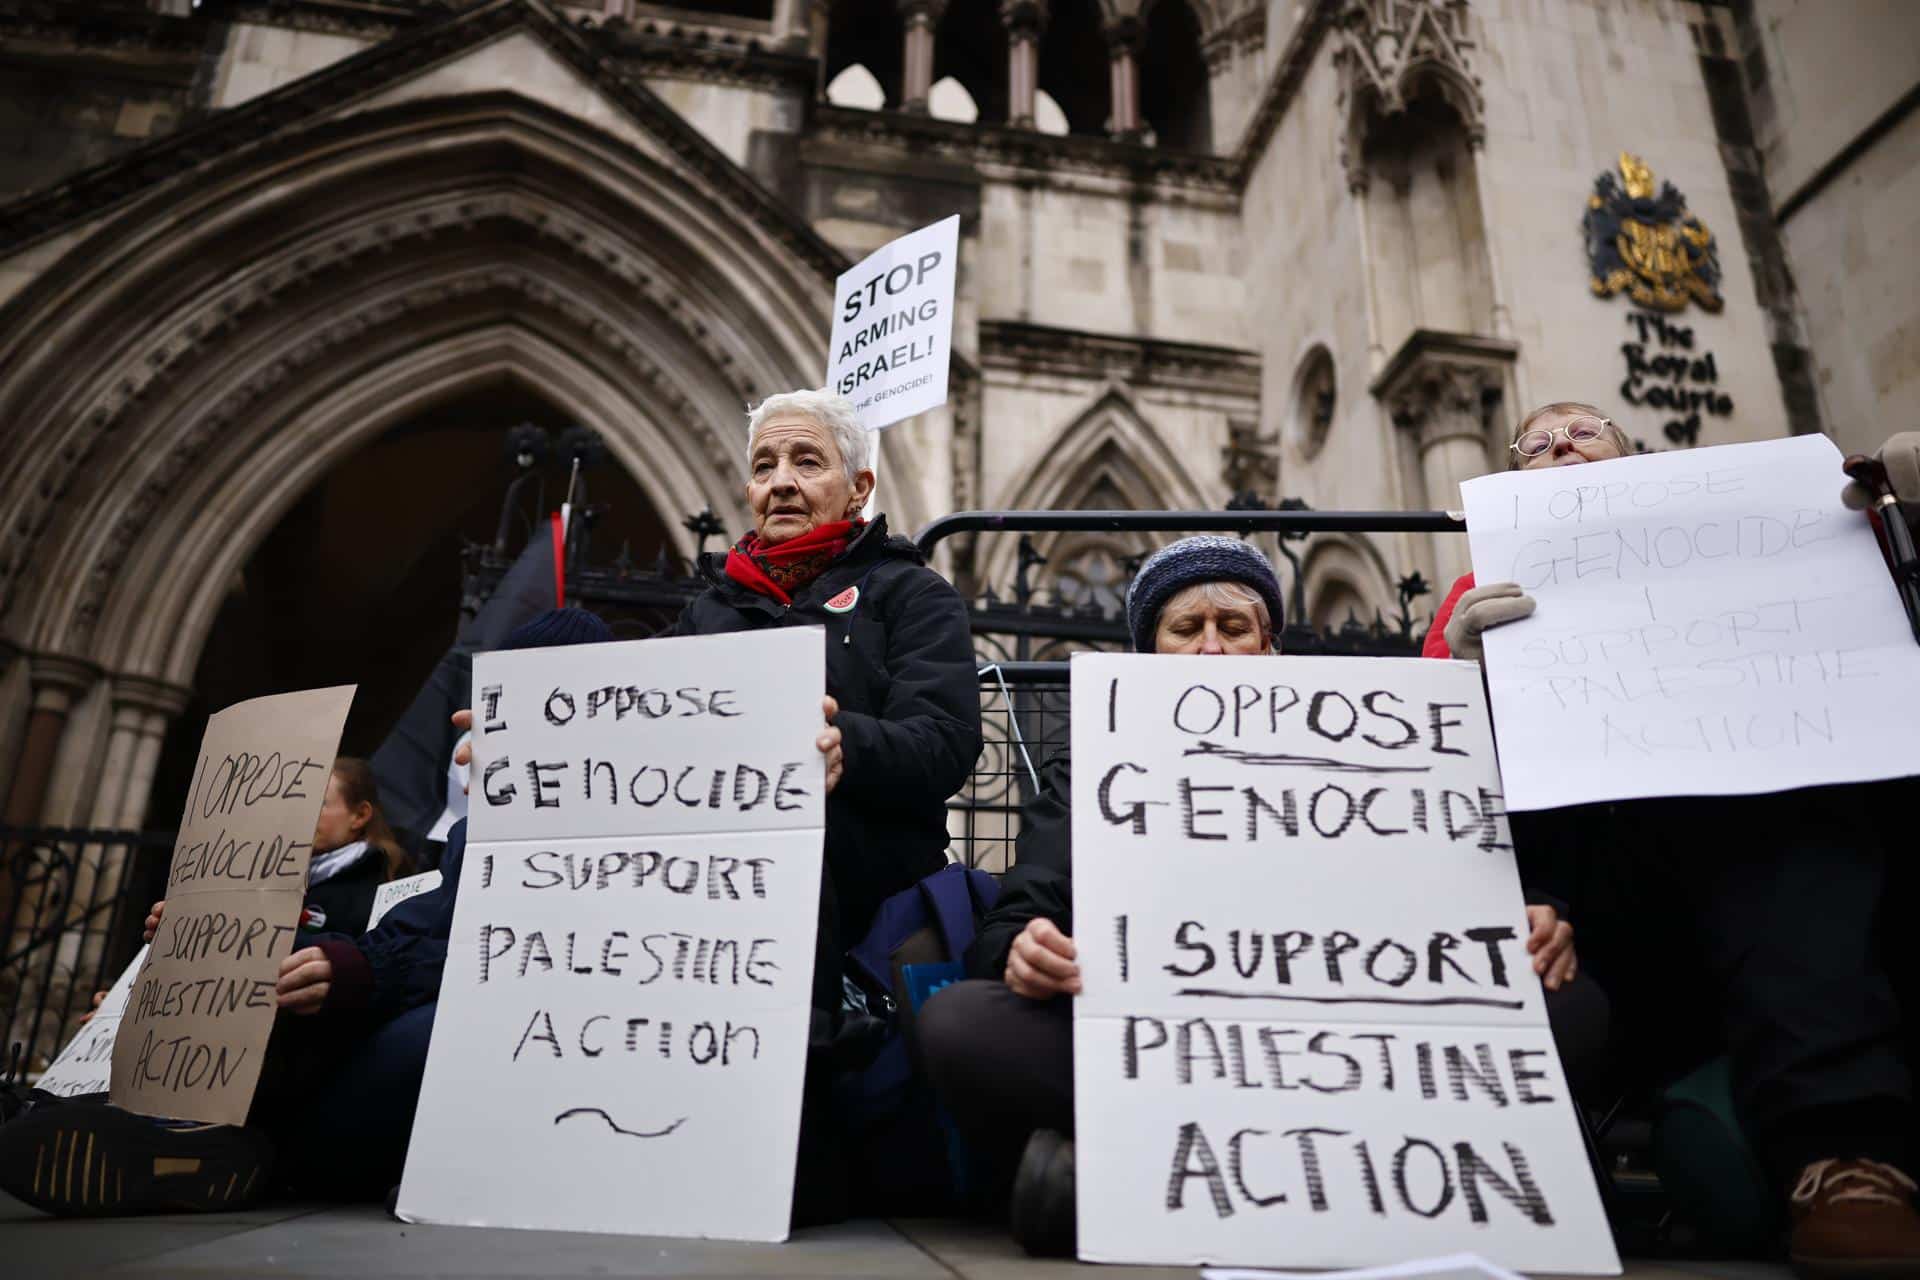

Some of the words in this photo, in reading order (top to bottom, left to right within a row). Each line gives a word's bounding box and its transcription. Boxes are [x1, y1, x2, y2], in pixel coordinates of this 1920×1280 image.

[843, 251, 942, 324] STOP
[838, 299, 938, 365] ARMING
[1626, 312, 1694, 348] The
[837, 335, 934, 396] ISRAEL!
[1621, 343, 1717, 383] Royal
[1621, 377, 1734, 417] Courts
[1512, 494, 1520, 530] I
[1547, 468, 1744, 522] OPPOSE
[1512, 508, 1838, 589] GENOCIDE
[1520, 595, 1833, 670] SUPPORT
[1644, 585, 1657, 621] I
[482, 684, 507, 734] I
[543, 685, 744, 726] OPPOSE
[1108, 678, 1118, 733] I
[1172, 684, 1470, 757] OPPOSE
[1602, 706, 1834, 757] ACTION
[187, 755, 208, 826] I
[203, 752, 324, 818] OPPOSE
[1098, 762, 1514, 853] GENOCIDE
[170, 829, 313, 887] GENOCIDE
[481, 854, 494, 889] I
[521, 850, 775, 900] SUPPORT
[162, 912, 296, 963] SUPPORT
[1113, 914, 1128, 983] I
[1162, 919, 1518, 989] SUPPORT
[135, 976, 278, 1024] PALESTINE
[131, 1029, 247, 1090] ACTION
[1123, 1015, 1556, 1108] PALESTINE
[1165, 1121, 1556, 1227] ACTION
